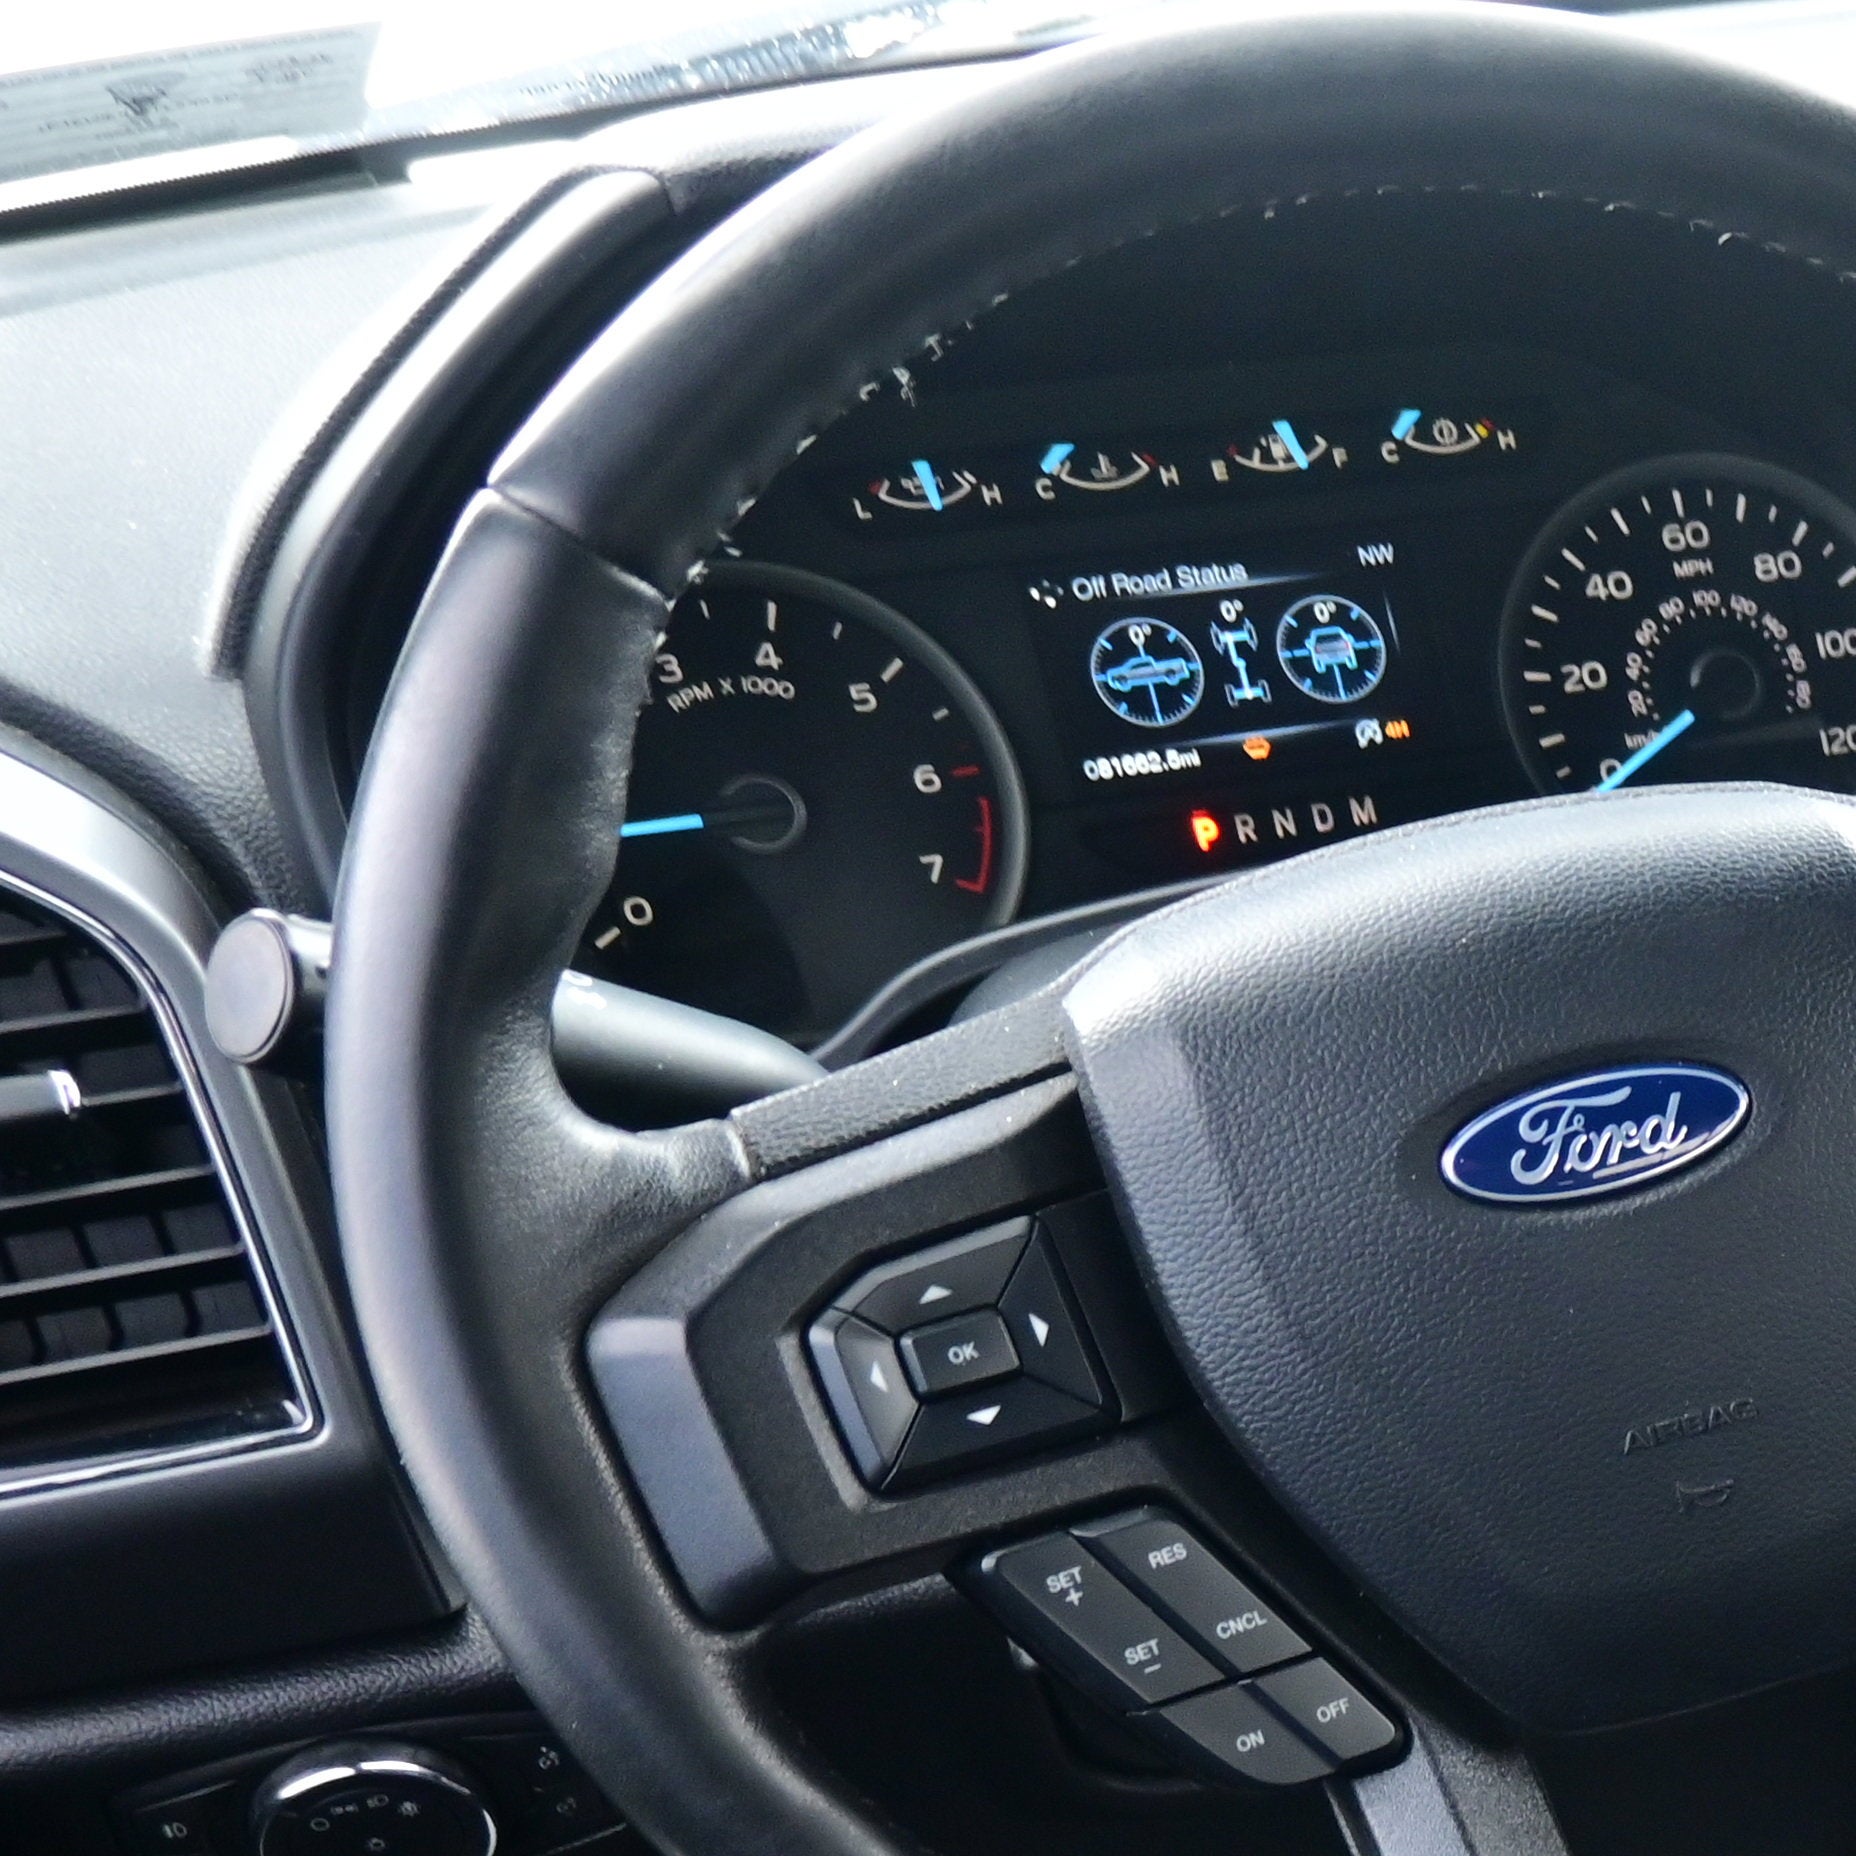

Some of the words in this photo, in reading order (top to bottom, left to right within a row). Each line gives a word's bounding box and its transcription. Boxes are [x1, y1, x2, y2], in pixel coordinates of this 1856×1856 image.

[1381, 441, 1400, 464] C
[1497, 429, 1518, 450] H
[1211, 460, 1229, 482] E
[1332, 448, 1348, 470] F
[1036, 478, 1056, 500] C
[1159, 464, 1181, 488] H
[981, 483, 1003, 507] H
[853, 498, 873, 521] L
[1662, 520, 1711, 551] 60
[1357, 542, 1394, 567] NW
[1672, 557, 1714, 579] MPH
[1753, 549, 1802, 582] 80
[1072, 576, 1106, 601] Off
[1111, 568, 1172, 597] Road
[1174, 563, 1248, 588] Status
[1585, 570, 1633, 601] 40
[1692, 589, 1721, 608] 100
[655, 653, 684, 684] 3
[755, 641, 783, 671] 4
[1560, 661, 1608, 694] 20
[667, 680, 714, 714] RPM
[740, 675, 795, 700] 1000
[849, 682, 877, 713] 5
[913, 764, 942, 794] 6
[1191, 810, 1219, 853] P
[1233, 812, 1258, 844] R
[1271, 806, 1298, 839] N
[1310, 802, 1335, 833] D
[1349, 795, 1378, 827] M
[919, 854, 943, 883] 7
[623, 896, 653, 926] 0
[1510, 1086, 1688, 1185] Ford
[947, 1340, 980, 1365] OK
[1623, 1400, 1759, 1455] AIRBAG
[1148, 1543, 1187, 1569] RES
[1046, 1566, 1082, 1593] SET
[1216, 1610, 1267, 1639] CNCL
[1124, 1638, 1160, 1666] SET
[1316, 1698, 1350, 1723] OFF
[1236, 1729, 1265, 1752] ON
